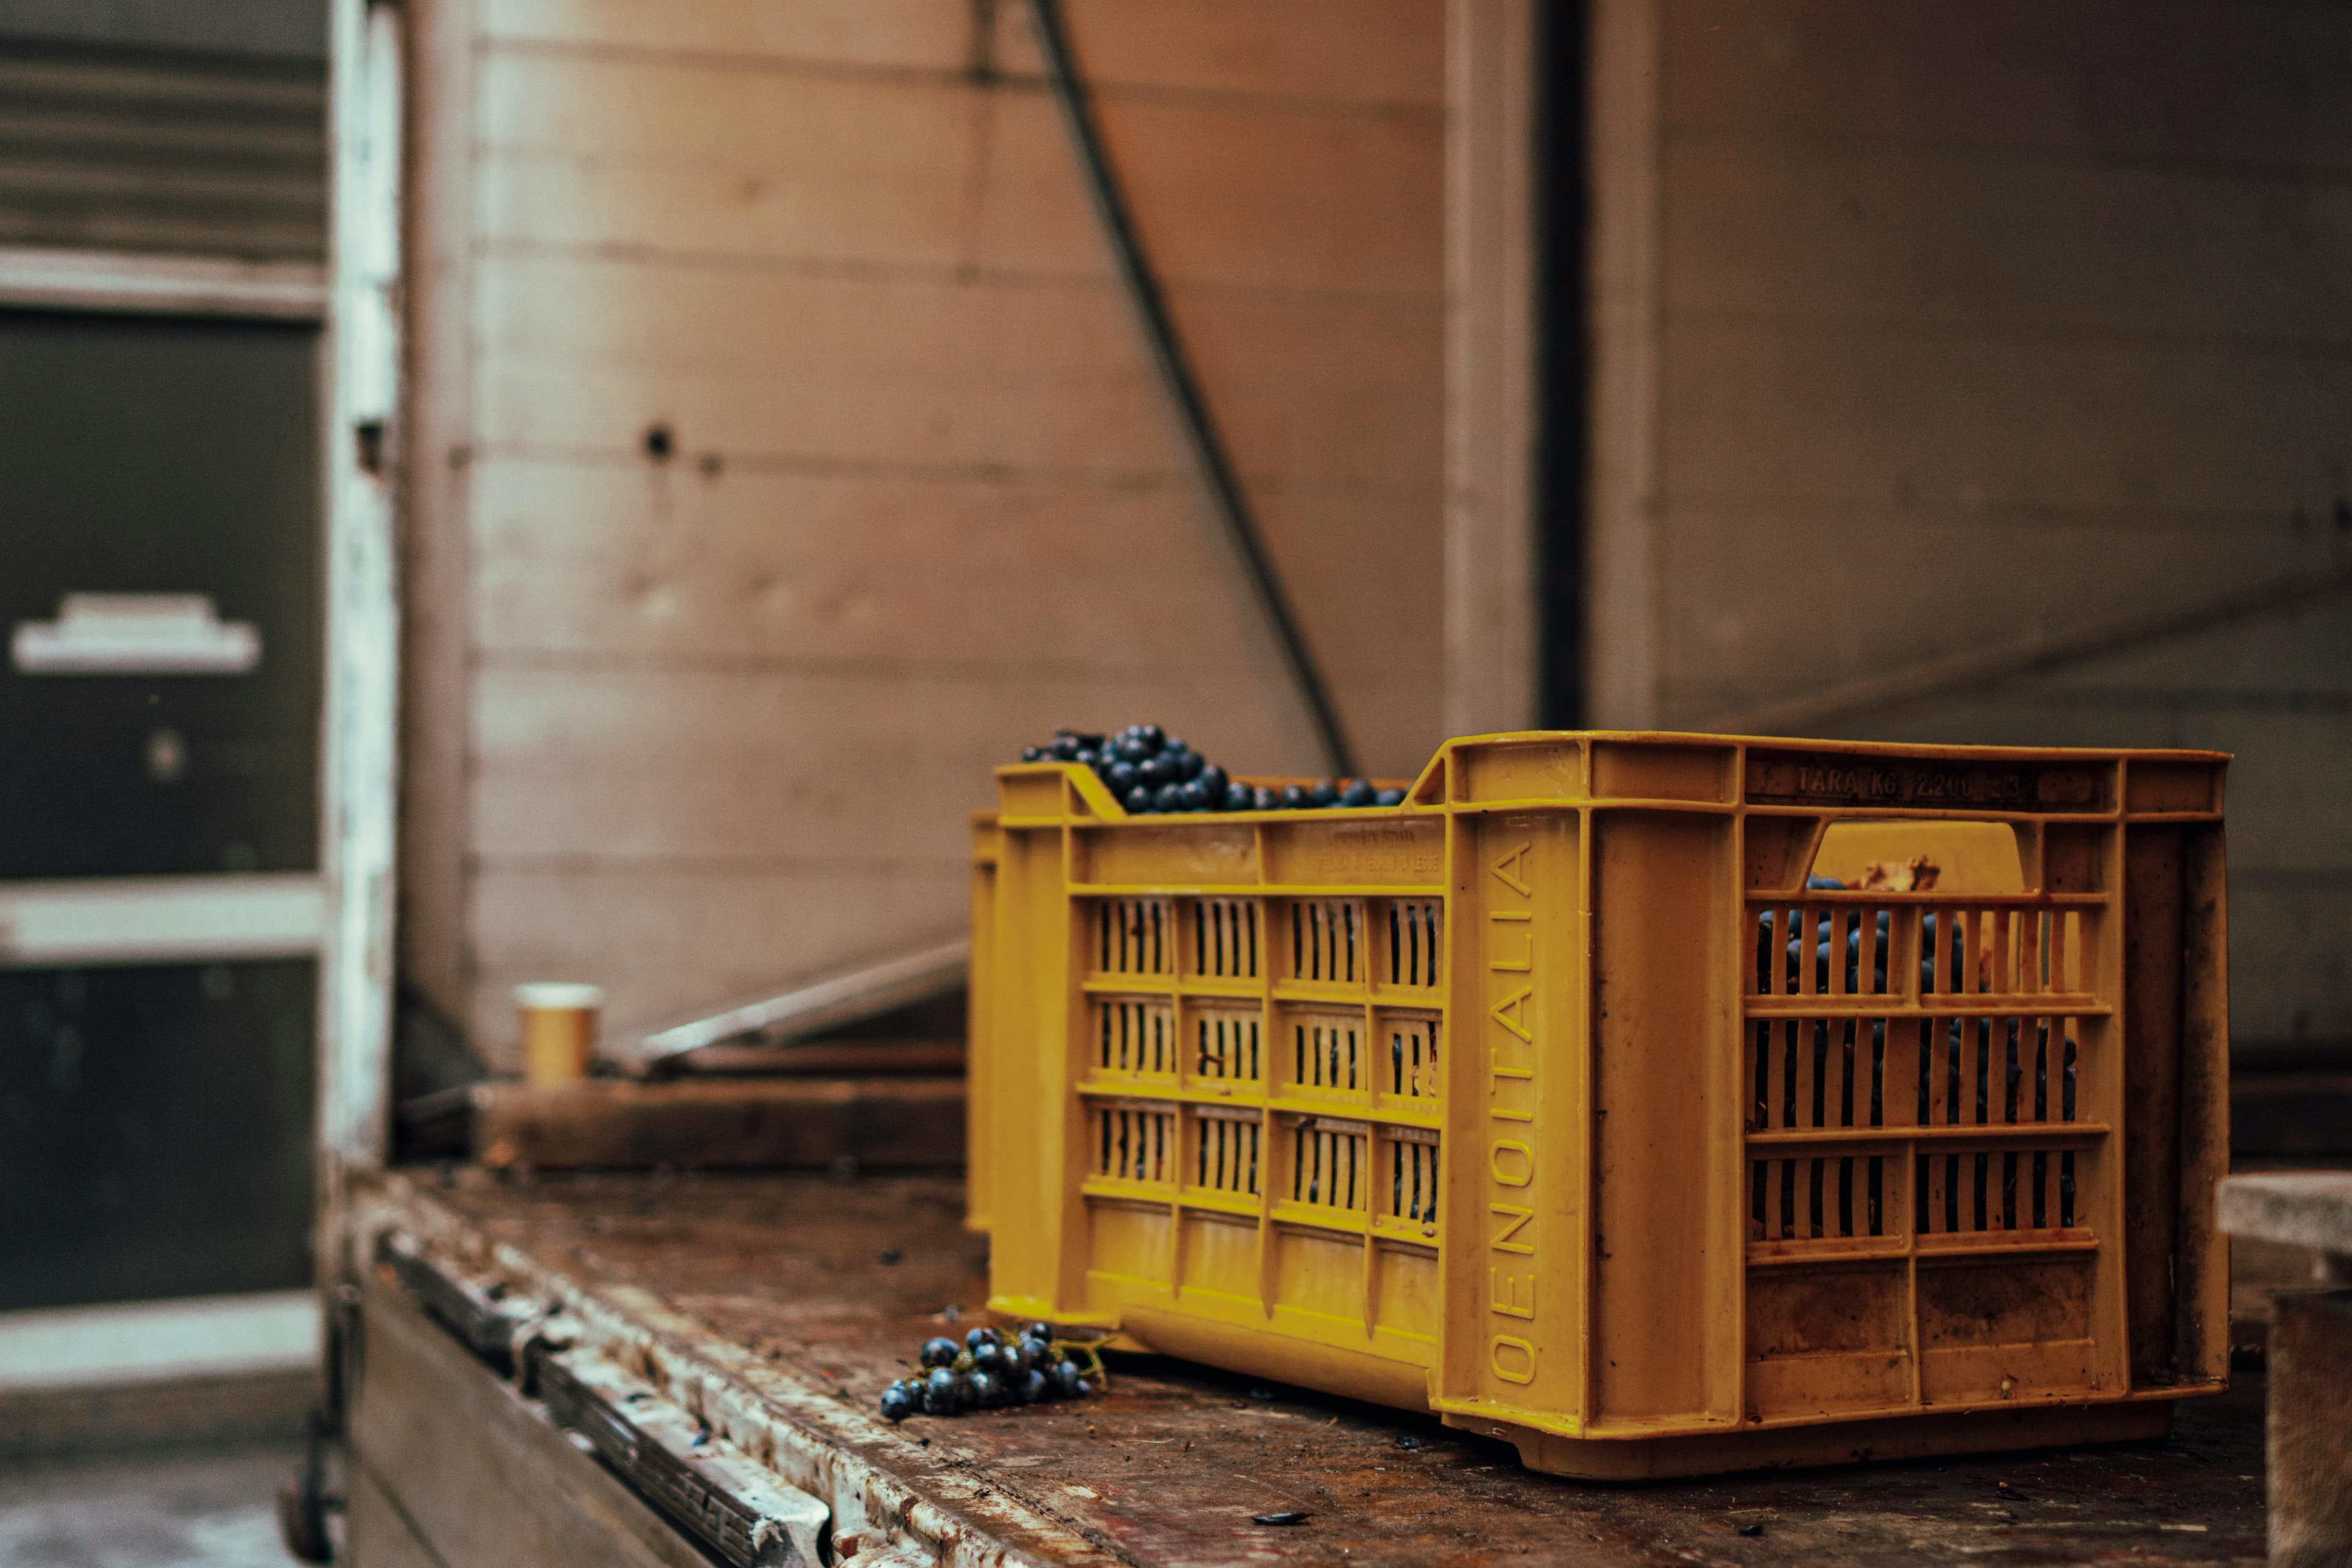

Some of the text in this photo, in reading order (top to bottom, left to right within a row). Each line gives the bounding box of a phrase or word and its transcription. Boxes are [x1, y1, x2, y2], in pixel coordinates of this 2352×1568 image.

[1798, 767, 1858, 793] TARA
[1871, 770, 1898, 795] KG
[1490, 842, 1536, 1387] OENOITALIA
